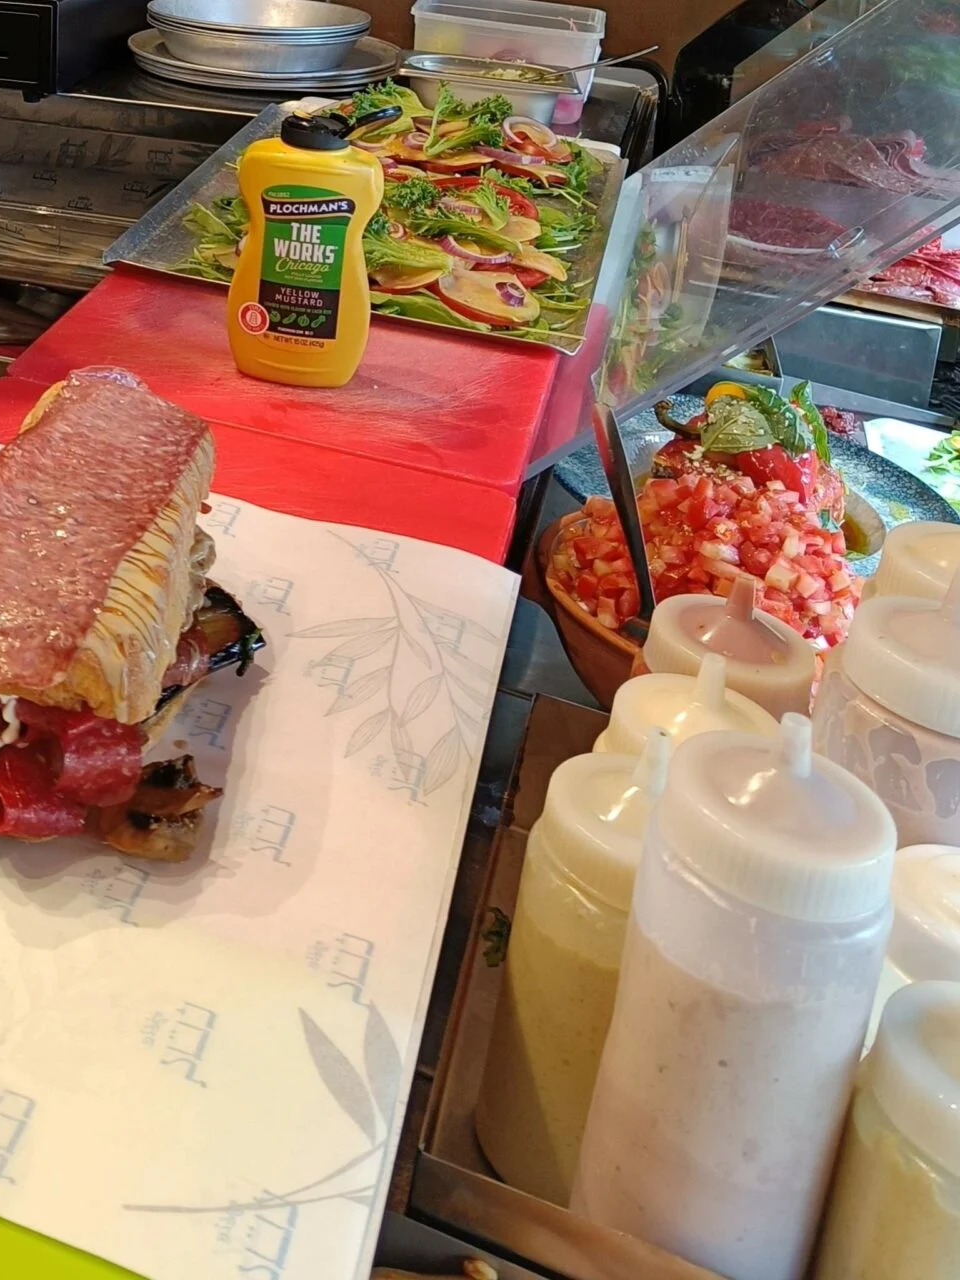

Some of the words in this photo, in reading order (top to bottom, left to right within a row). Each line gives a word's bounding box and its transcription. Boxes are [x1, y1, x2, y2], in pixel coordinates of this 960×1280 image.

[269, 199, 350, 214] PLOCHMAN'S
[290, 222, 322, 243] THE
[273, 238, 336, 264] WORKS
[275, 257, 330, 275] Chicago
[275, 294, 324, 307] MUSTARD
[280, 287, 320, 299] YELLOW
